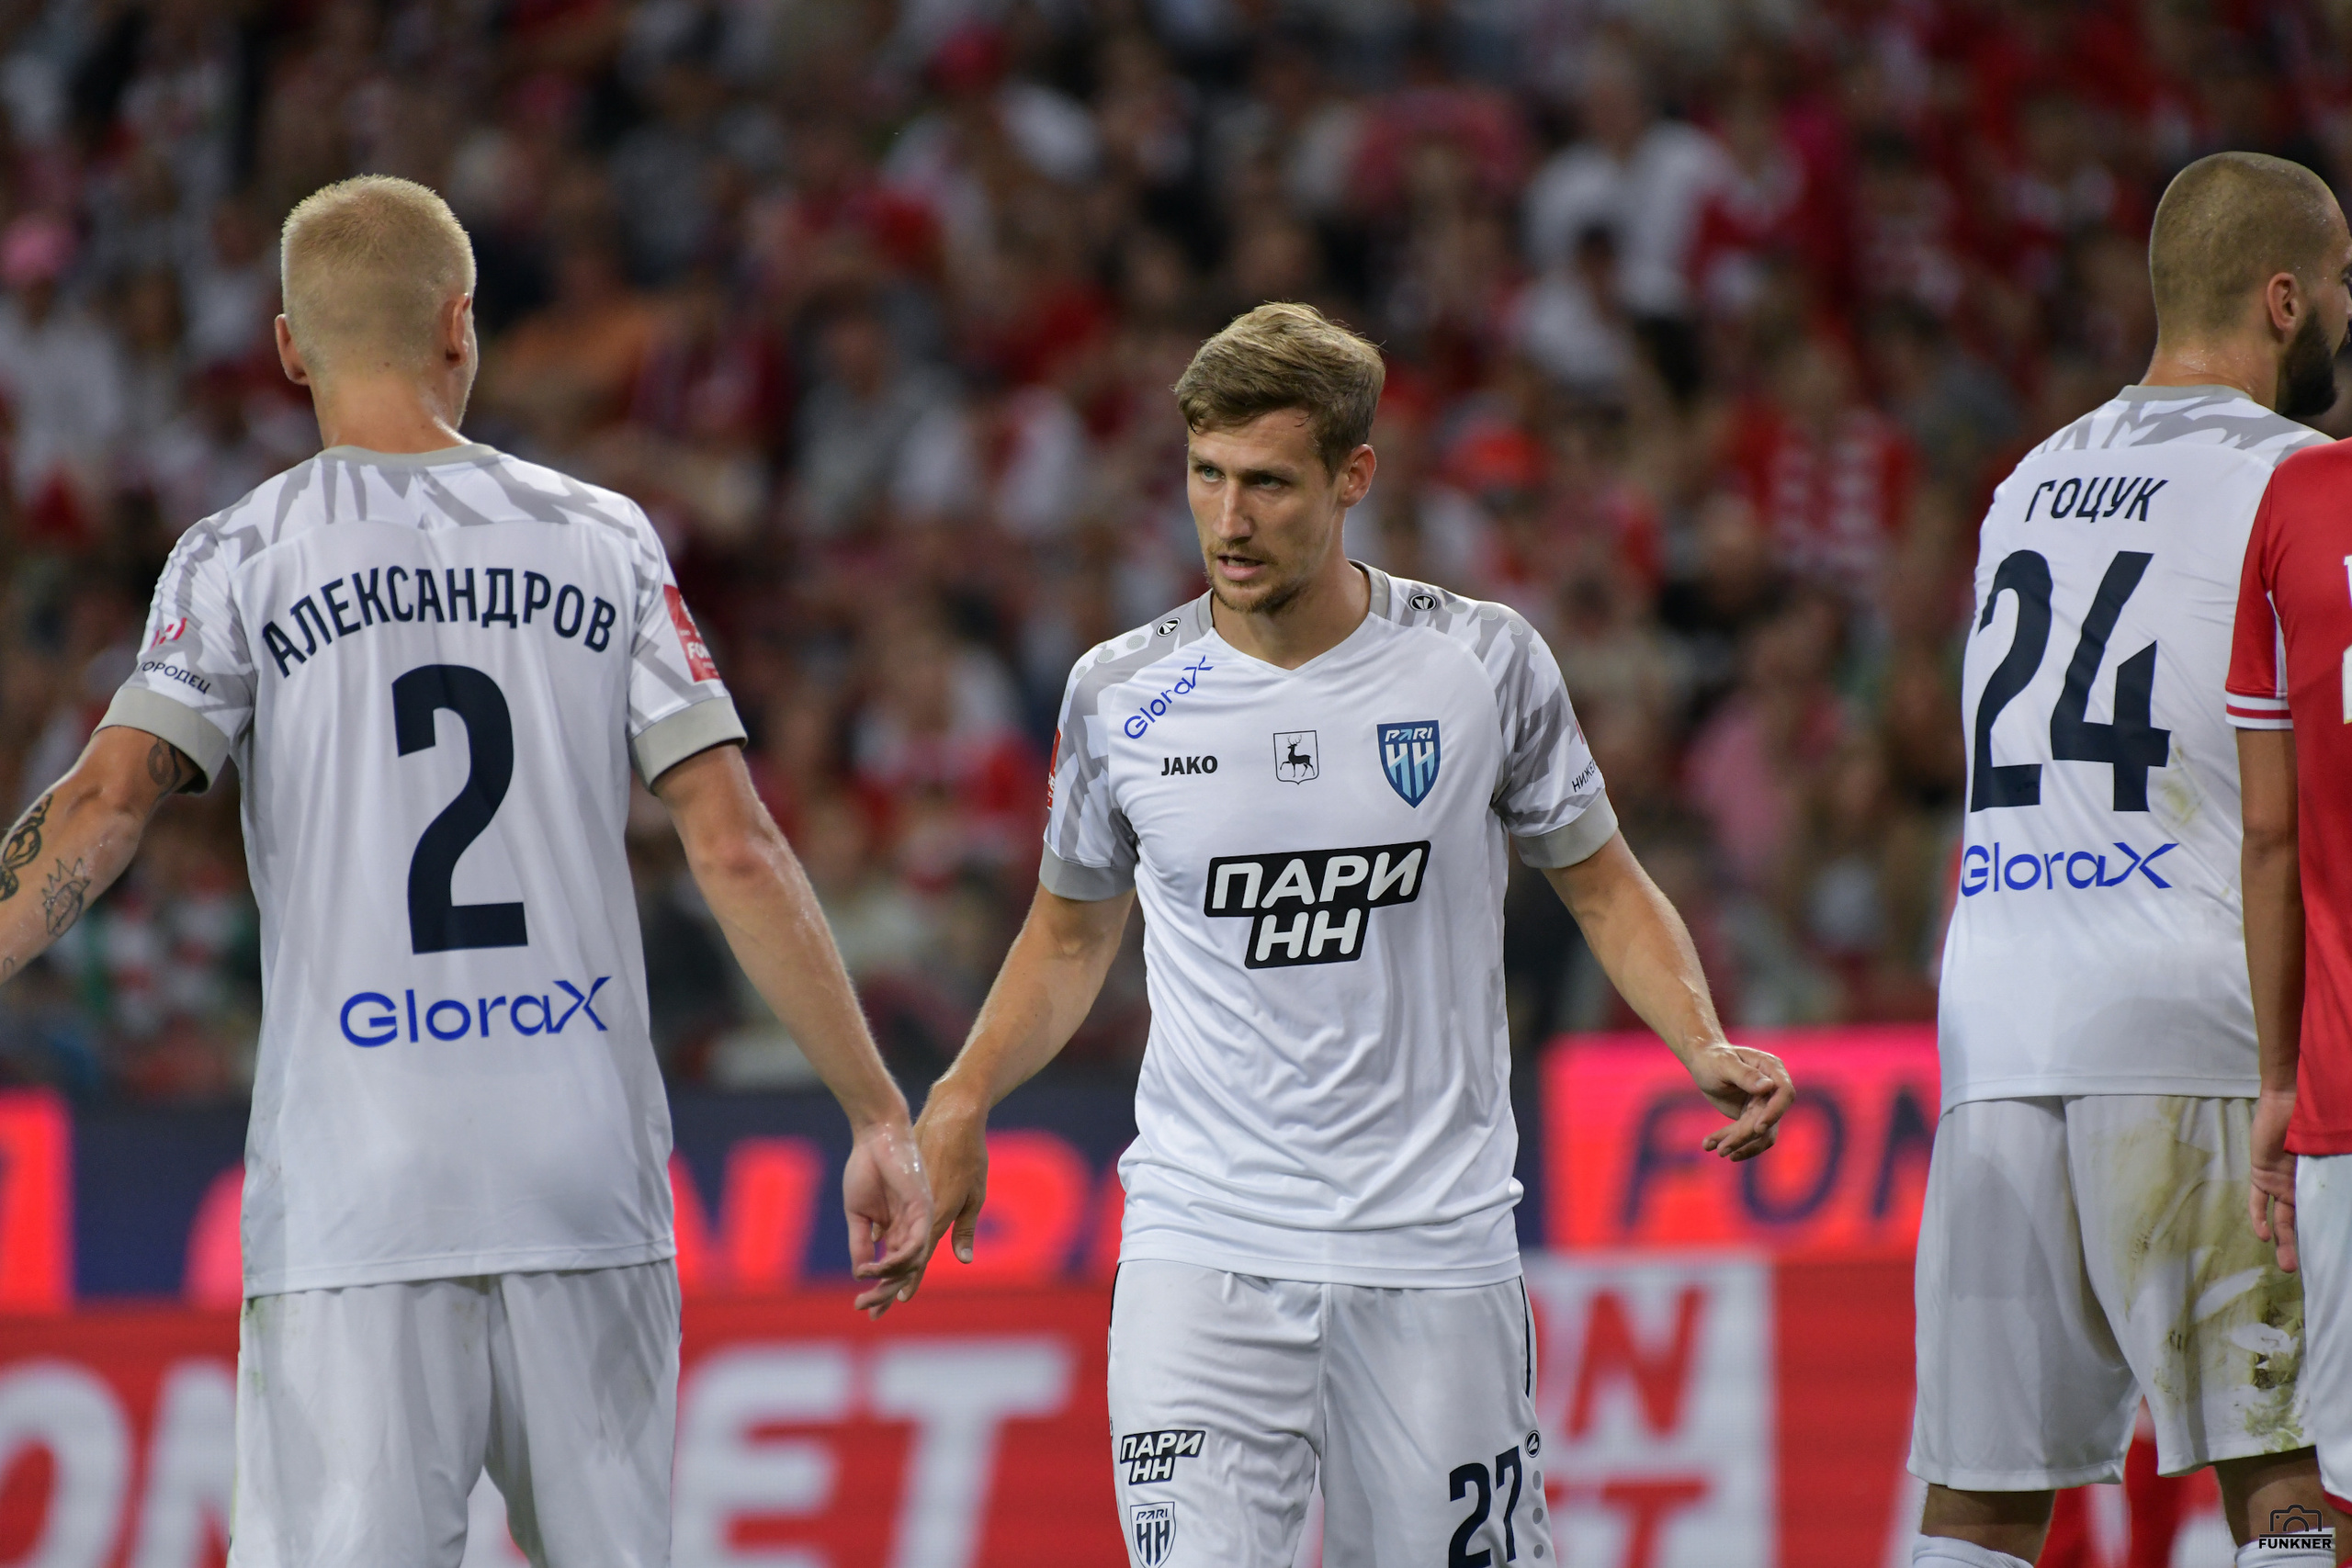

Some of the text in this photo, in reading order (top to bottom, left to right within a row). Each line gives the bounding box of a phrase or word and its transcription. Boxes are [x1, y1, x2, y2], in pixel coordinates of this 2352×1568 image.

[2025, 477, 2168, 523] ГОЦУК
[261, 566, 616, 678] АЛЕКСАНДРОВ
[1125, 655, 1214, 739] GloraX
[1970, 549, 2171, 812] 24
[1161, 755, 1217, 776] JAKO
[391, 664, 528, 954] 2
[1212, 848, 1422, 908] ПАРИ
[1962, 841, 2179, 897] GloraX
[1255, 908, 1362, 962] НН
[340, 976, 612, 1048] GloraX
[1121, 1433, 1203, 1461] ПАРИ
[1131, 1457, 1172, 1483] НН
[1448, 1445, 1522, 1568] 27
